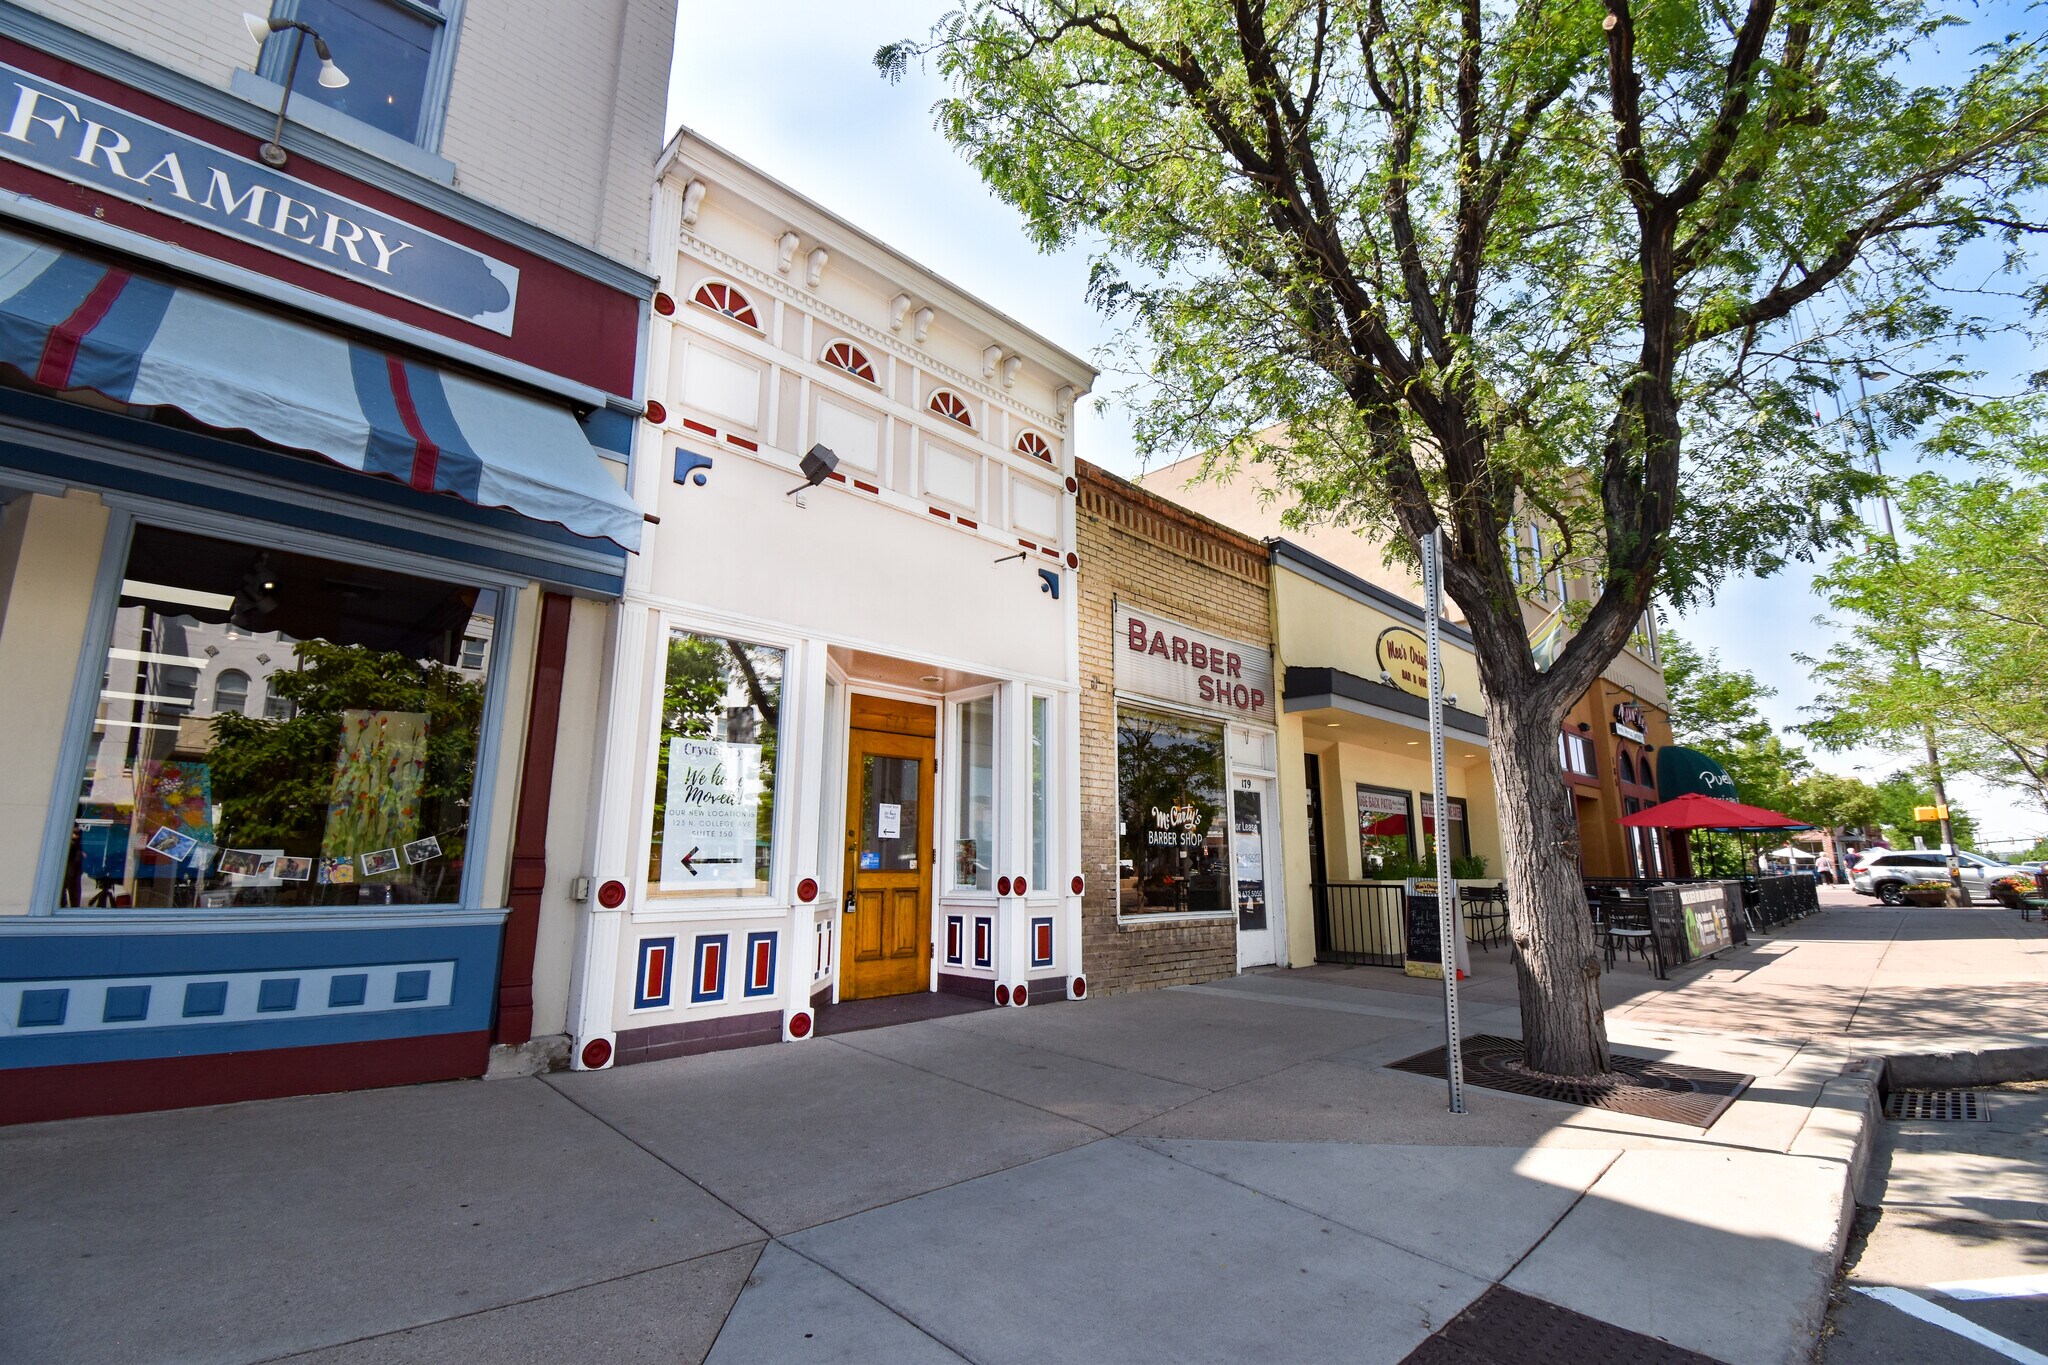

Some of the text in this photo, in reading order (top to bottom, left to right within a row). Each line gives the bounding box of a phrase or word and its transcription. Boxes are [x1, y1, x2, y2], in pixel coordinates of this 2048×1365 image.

[1, 82, 413, 276] FRAMERY
[1128, 617, 1242, 679] BARBER
[1409, 646, 1428, 671] Origi
[1198, 675, 1265, 711] SHOP
[684, 763, 743, 787] We hae
[673, 819, 685, 827] 123
[1151, 803, 1202, 830] McCarty's
[1241, 821, 1258, 832] Lease
[1148, 830, 1203, 846] BARBER SHOP
